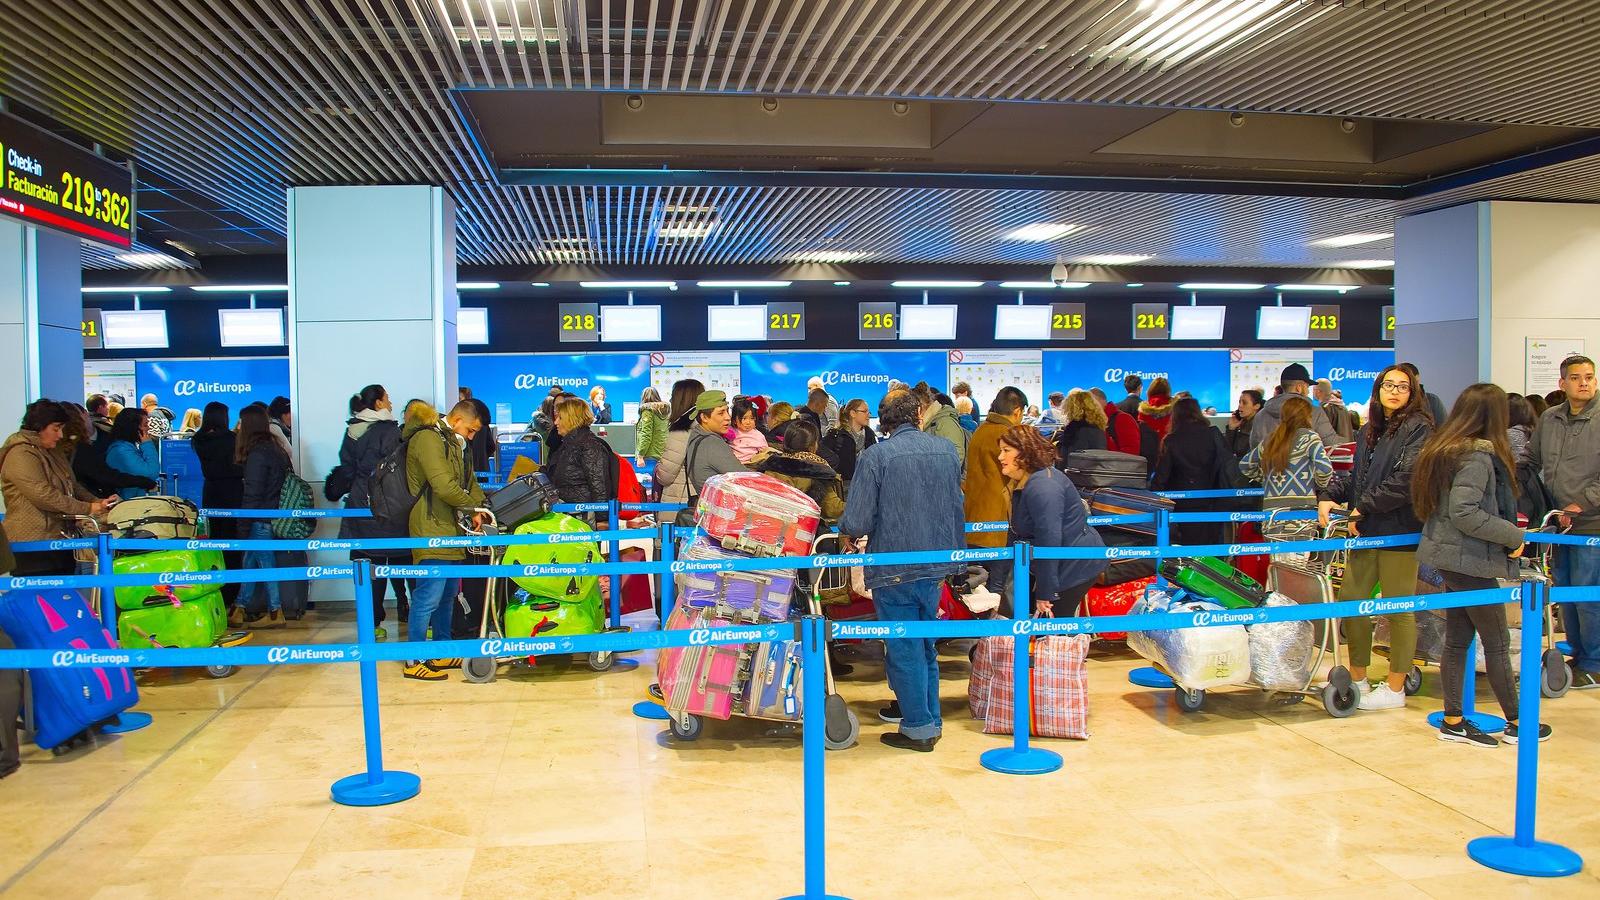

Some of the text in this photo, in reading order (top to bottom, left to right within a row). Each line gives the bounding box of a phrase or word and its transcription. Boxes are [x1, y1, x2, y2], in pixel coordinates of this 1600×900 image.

[8, 148, 42, 176] Check-in
[8, 170, 58, 204] Facturación
[62, 172, 130, 230] 219 to 362
[562, 314, 594, 330] 218
[770, 314, 801, 329] 217
[863, 314, 893, 328] 216
[1053, 314, 1082, 329] 215
[1137, 314, 1166, 329] 214
[1310, 315, 1337, 330] 213
[840, 373, 889, 384] AirEuropa
[1346, 370, 1380, 381] AirEurop
[197, 381, 251, 393] AirEuropa
[536, 377, 588, 388] AirEuropa
[62, 541, 92, 549] AirEuropa
[199, 540, 230, 549] AirEuropa
[1356, 540, 1384, 548] AirEuropa
[1242, 546, 1271, 554] AirEuropa
[964, 552, 998, 560] AirEuropa
[686, 562, 722, 571] AirEuropa
[828, 558, 863, 566] AirEuropa
[322, 568, 353, 577] AirEurop
[391, 568, 428, 576] AirEuropa
[539, 567, 576, 575] AirEuropa
[26, 579, 63, 588] AirEuropa
[174, 574, 211, 583] AirEuropa
[1375, 602, 1414, 612] AirEuropa
[1211, 614, 1253, 623] AirEuropa
[840, 626, 890, 636] AirEuropa
[1032, 622, 1078, 633] AirEuropa
[710, 631, 761, 642] AirEuropa
[503, 642, 555, 653] AirEuropa
[75, 654, 129, 664] AirEuropa
[291, 650, 344, 661] AirEuropa
